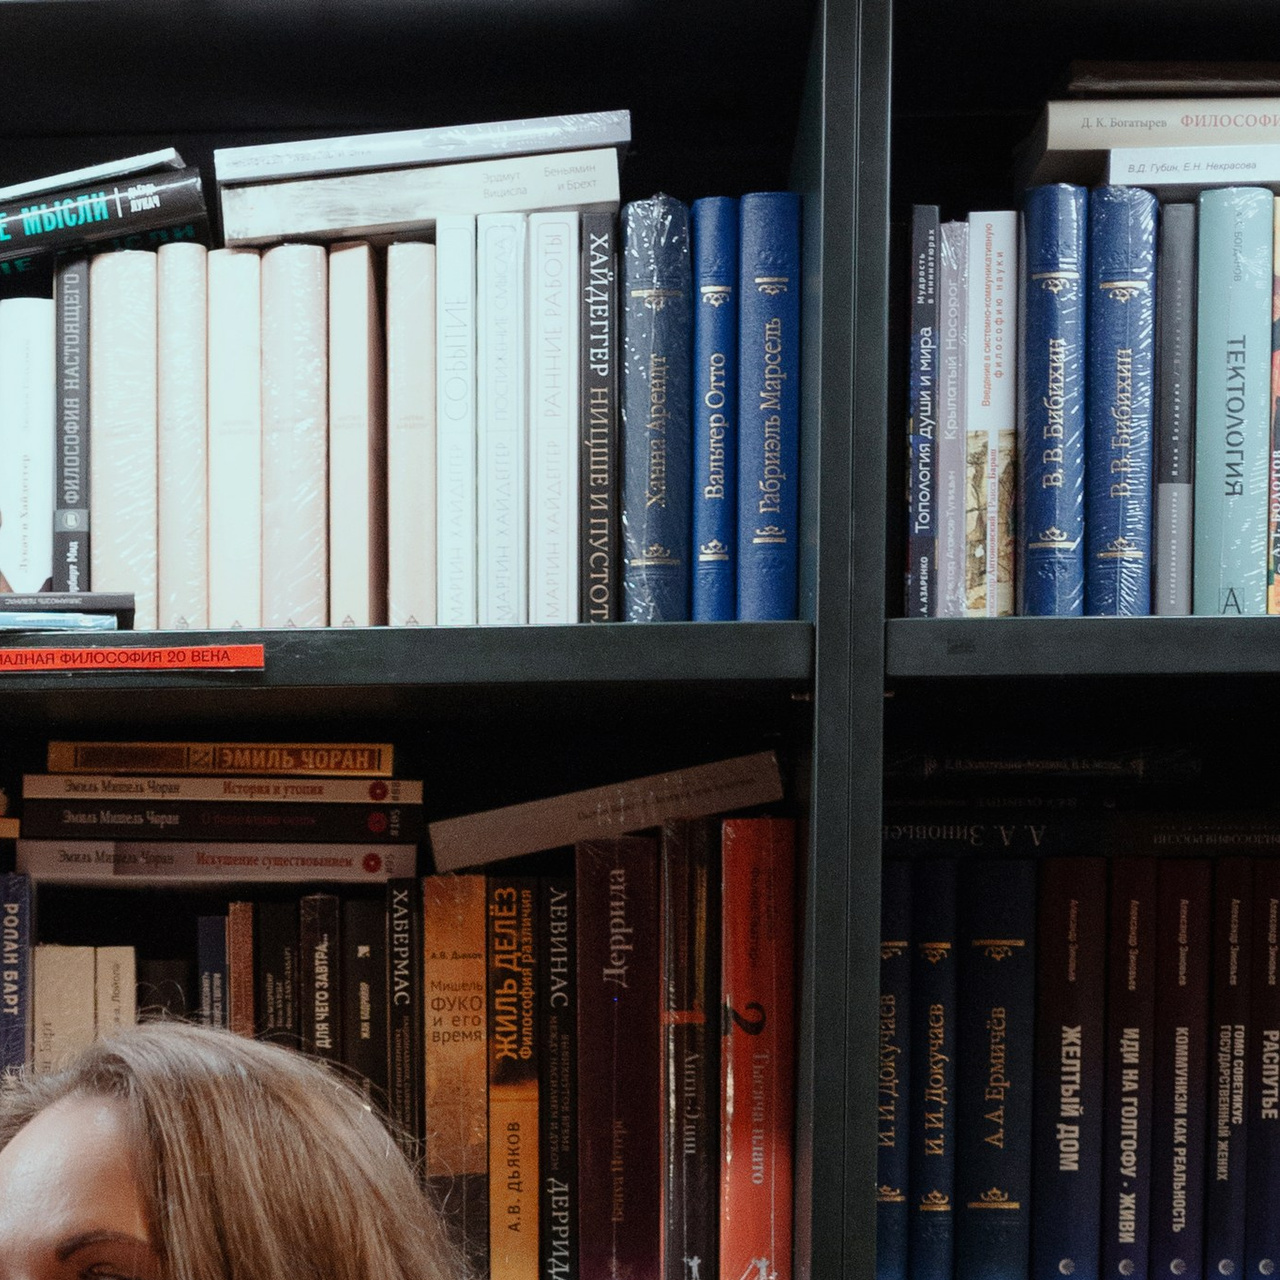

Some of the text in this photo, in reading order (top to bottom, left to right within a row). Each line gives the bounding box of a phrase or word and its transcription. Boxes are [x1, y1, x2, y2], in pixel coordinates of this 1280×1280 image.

[1096, 118, 1106, 128] К.
[1110, 117, 1167, 131] Богатырев
[21, 192, 109, 237] МЫСЛИ
[64, 272, 81, 505] ФИЛОСОФИЯ НАСТОЯЩЕГО
[588, 233, 609, 623] ХАЙДЕГГЕР НИЦШЕ И ПУСТОТ
[646, 354, 668, 508] Ханна Арендт
[704, 353, 726, 500] Вальтер Отто
[759, 318, 787, 513] Габриэль Марсель
[915, 327, 935, 534] Топология души и мира
[1224, 334, 1246, 497] ТЕКТОЛОГИЯ
[60, 651, 162, 664] ФИЛОСОФИЯ
[170, 651, 186, 662] 20
[191, 650, 230, 662] ВЕКА
[220, 747, 370, 770] ЭМИЛЬ ЧОРАН
[2, 903, 19, 1016] РОЛАН БАРТ
[392, 890, 410, 1006] ХАБЕРМАС
[431, 980, 483, 992] Мишель
[431, 996, 482, 1011] ФУКО
[490, 887, 519, 1061] ЖИЛЬ ДЕЛЁЗ
[549, 887, 568, 1008] ЛЕВИНАС
[432, 1031, 482, 1044] время
[433, 1016, 481, 1029] и его
[1261, 1030, 1279, 1120] РАСПУТЬЕ
[1056, 1025, 1084, 1171] ЖЕЛТЫЙ ДОМ
[1172, 1027, 1189, 1233] КОММУНИЗМ КАК РЕАЛЬНОСТЬ
